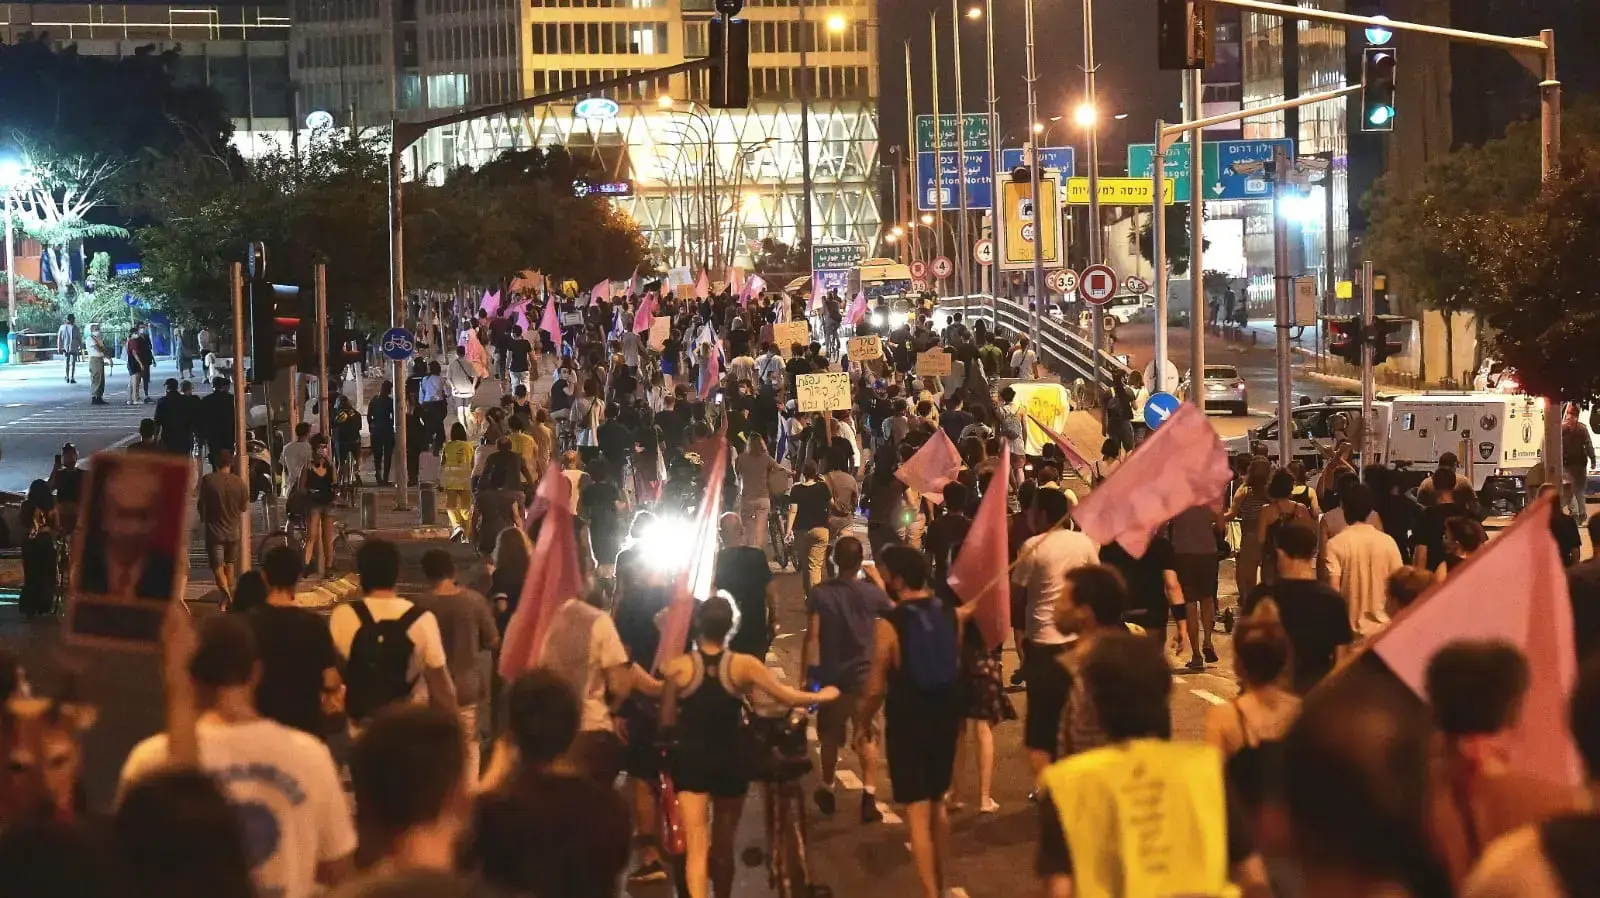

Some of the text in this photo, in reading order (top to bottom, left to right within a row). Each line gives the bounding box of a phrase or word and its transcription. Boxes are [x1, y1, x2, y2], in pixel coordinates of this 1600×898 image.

[964, 176, 992, 185] North
[1120, 186, 1148, 196] כניסה
[983, 245, 991, 256] 4
[939, 261, 946, 271] 4
[1058, 277, 1074, 287] 3.5
[1129, 281, 1145, 290] 3.5
